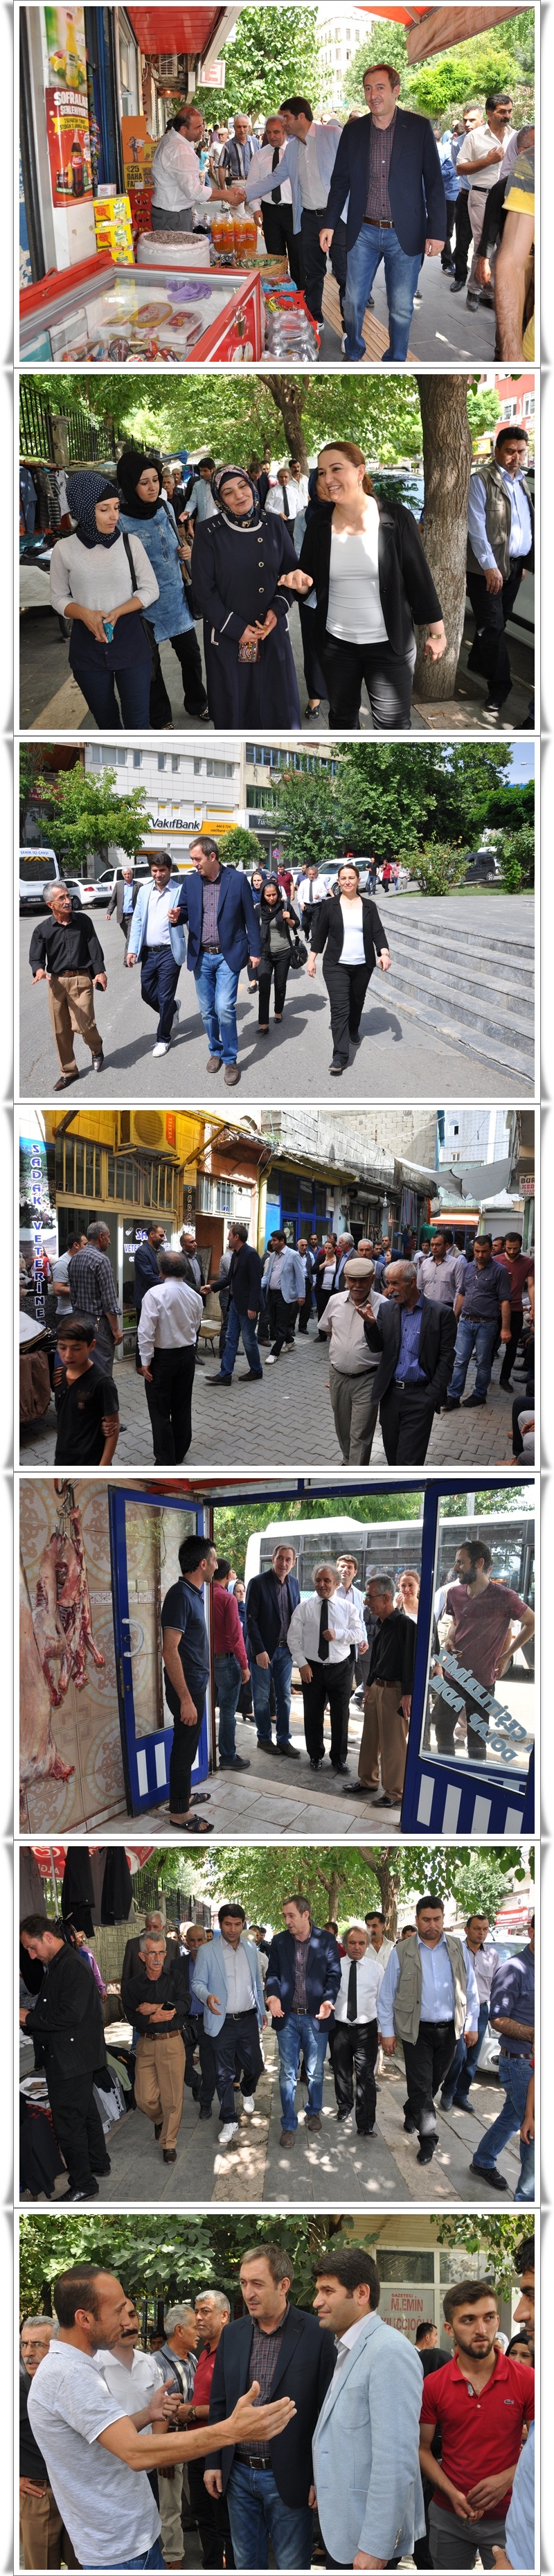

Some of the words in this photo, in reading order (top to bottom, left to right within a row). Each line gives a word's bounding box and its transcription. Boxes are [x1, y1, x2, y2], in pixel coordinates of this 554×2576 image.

[152, 818, 200, 830] VakıfBank
[31, 1144, 42, 1204] SADAK
[391, 2296, 423, 2312] M.EMİN
